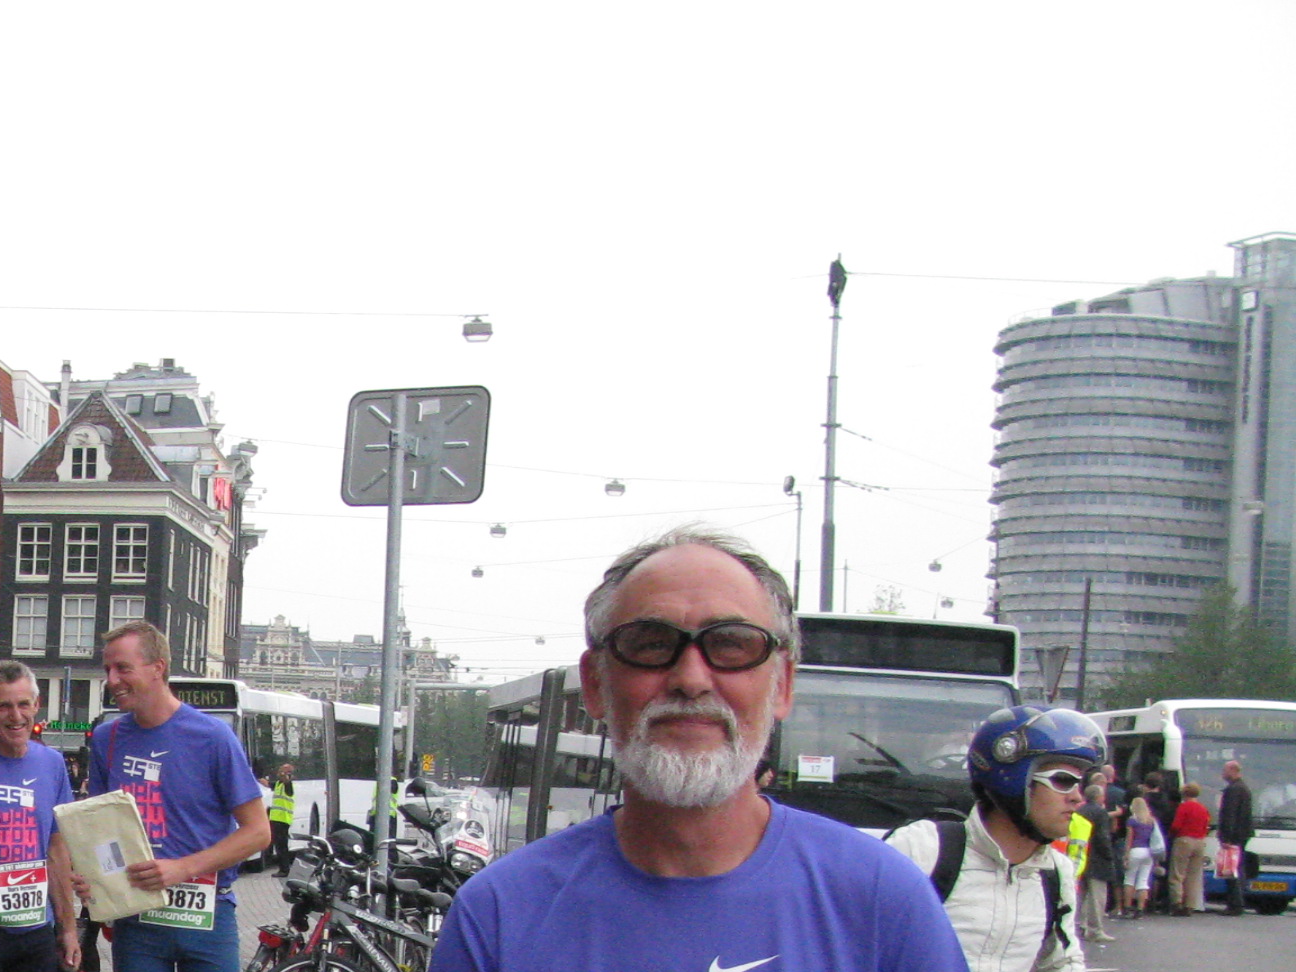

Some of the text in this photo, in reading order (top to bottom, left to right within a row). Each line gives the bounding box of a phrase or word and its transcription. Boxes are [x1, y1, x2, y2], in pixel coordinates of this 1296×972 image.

[50, 719, 93, 730] Heineke
[1, 890, 43, 911] 53878
[165, 888, 207, 910] 3873
[147, 909, 203, 926] maandag
